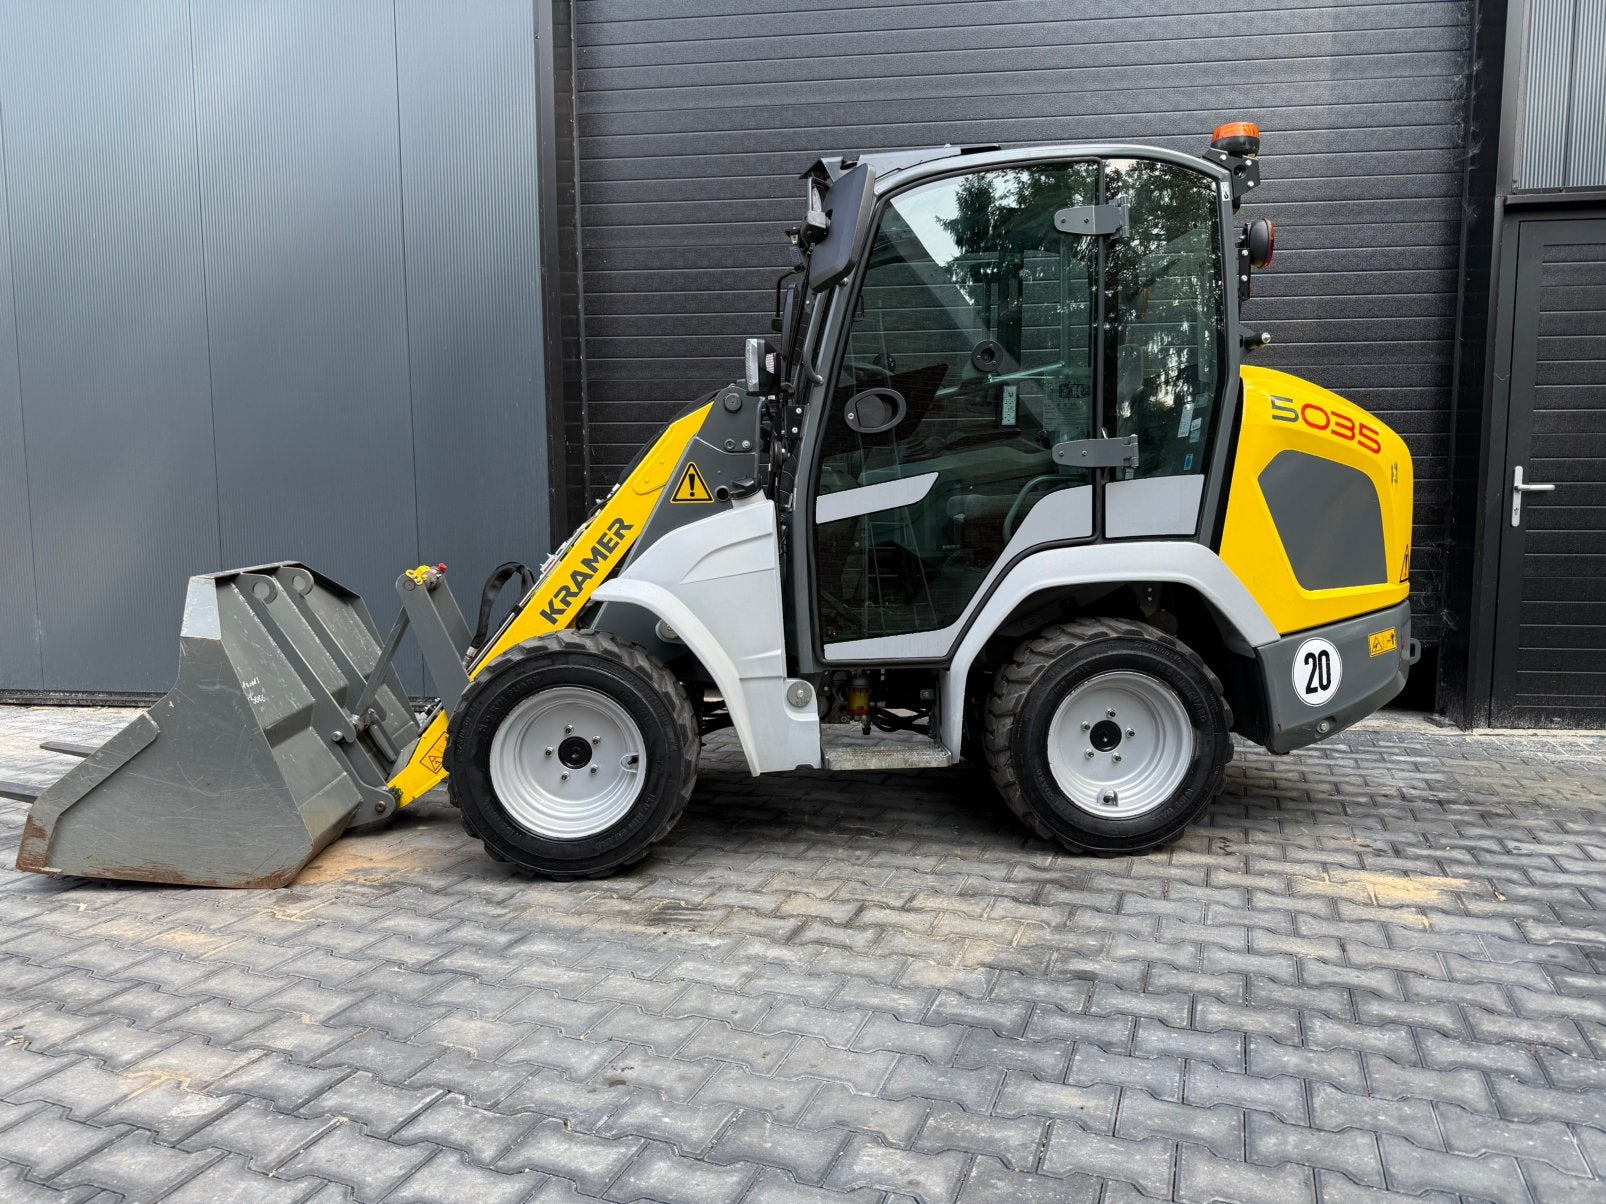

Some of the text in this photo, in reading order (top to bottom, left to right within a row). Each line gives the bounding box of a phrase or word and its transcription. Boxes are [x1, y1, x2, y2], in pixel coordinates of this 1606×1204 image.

[1270, 395, 1381, 454] 5035
[539, 517, 634, 625] KRAMER
[1304, 649, 1332, 694] 20
